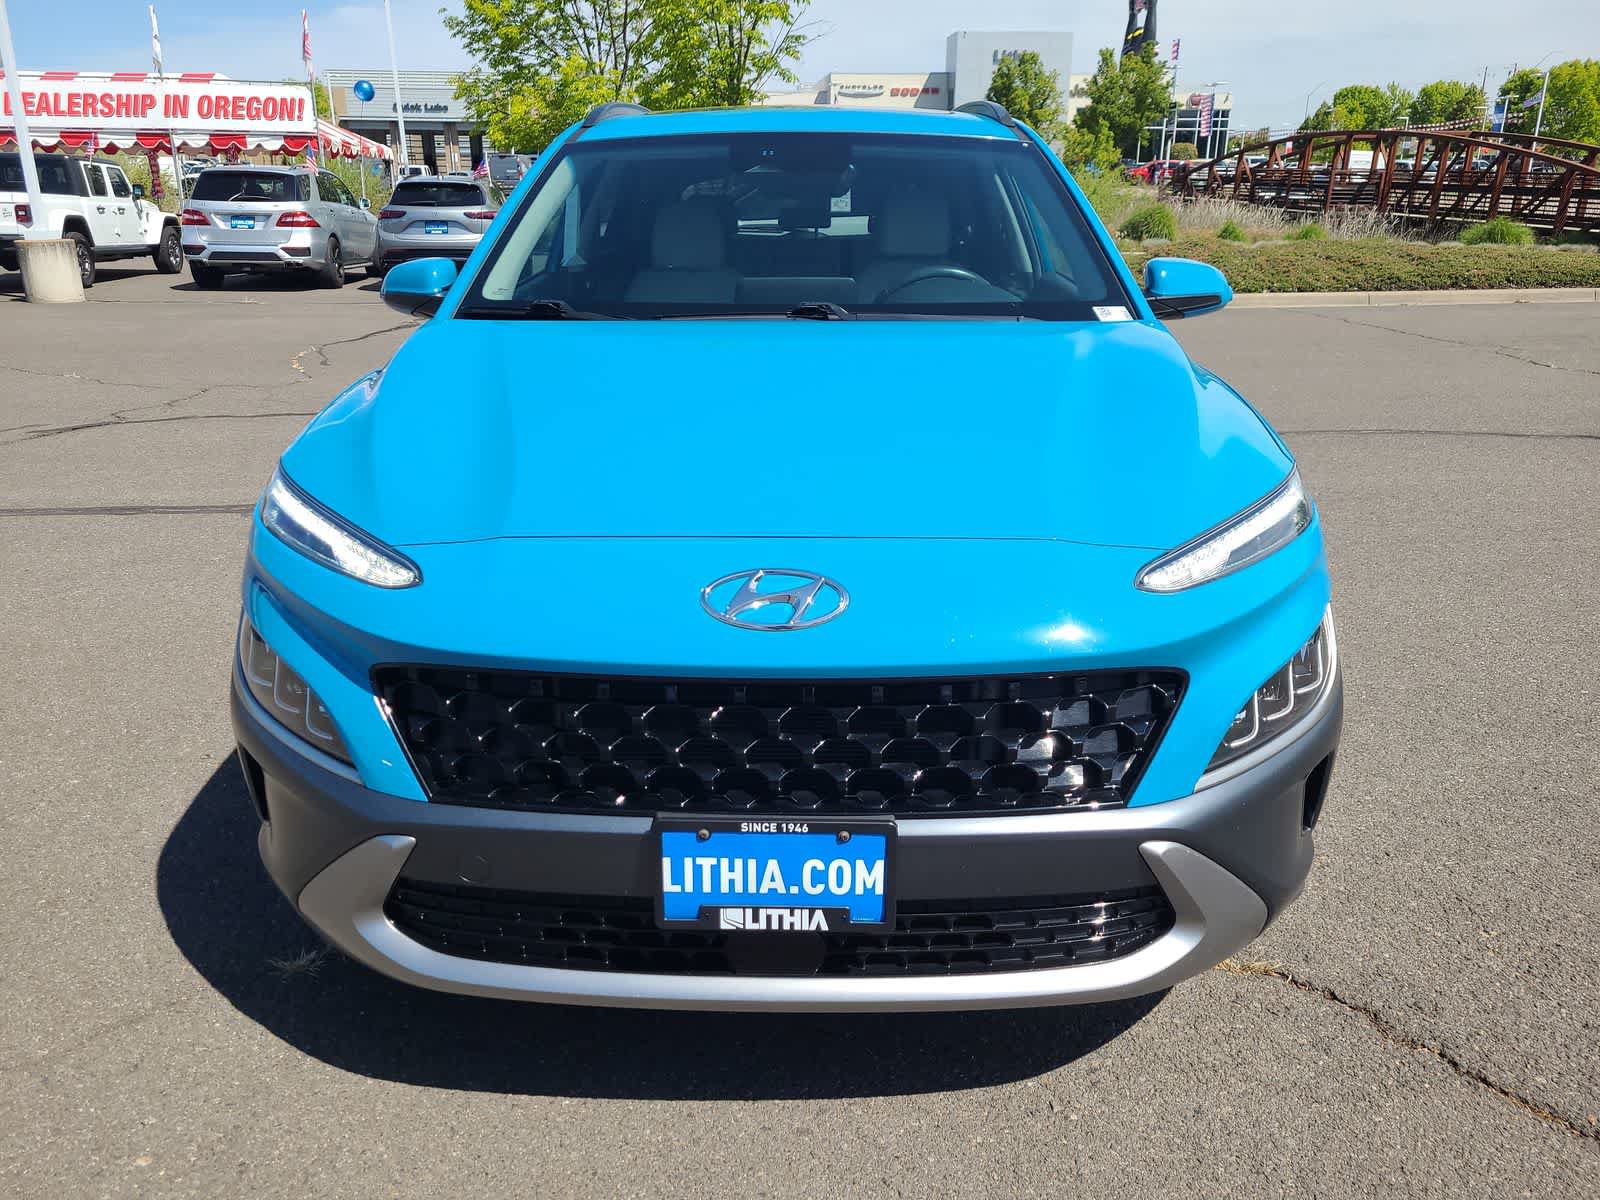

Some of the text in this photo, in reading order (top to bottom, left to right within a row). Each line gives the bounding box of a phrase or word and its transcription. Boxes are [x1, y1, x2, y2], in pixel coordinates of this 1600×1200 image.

[163, 94, 190, 118] IN
[197, 95, 305, 121] OREGON!
[740, 822, 809, 833] SINCE 1946
[662, 857, 885, 896] LITHIA.COM
[745, 908, 829, 931] LITHIA
